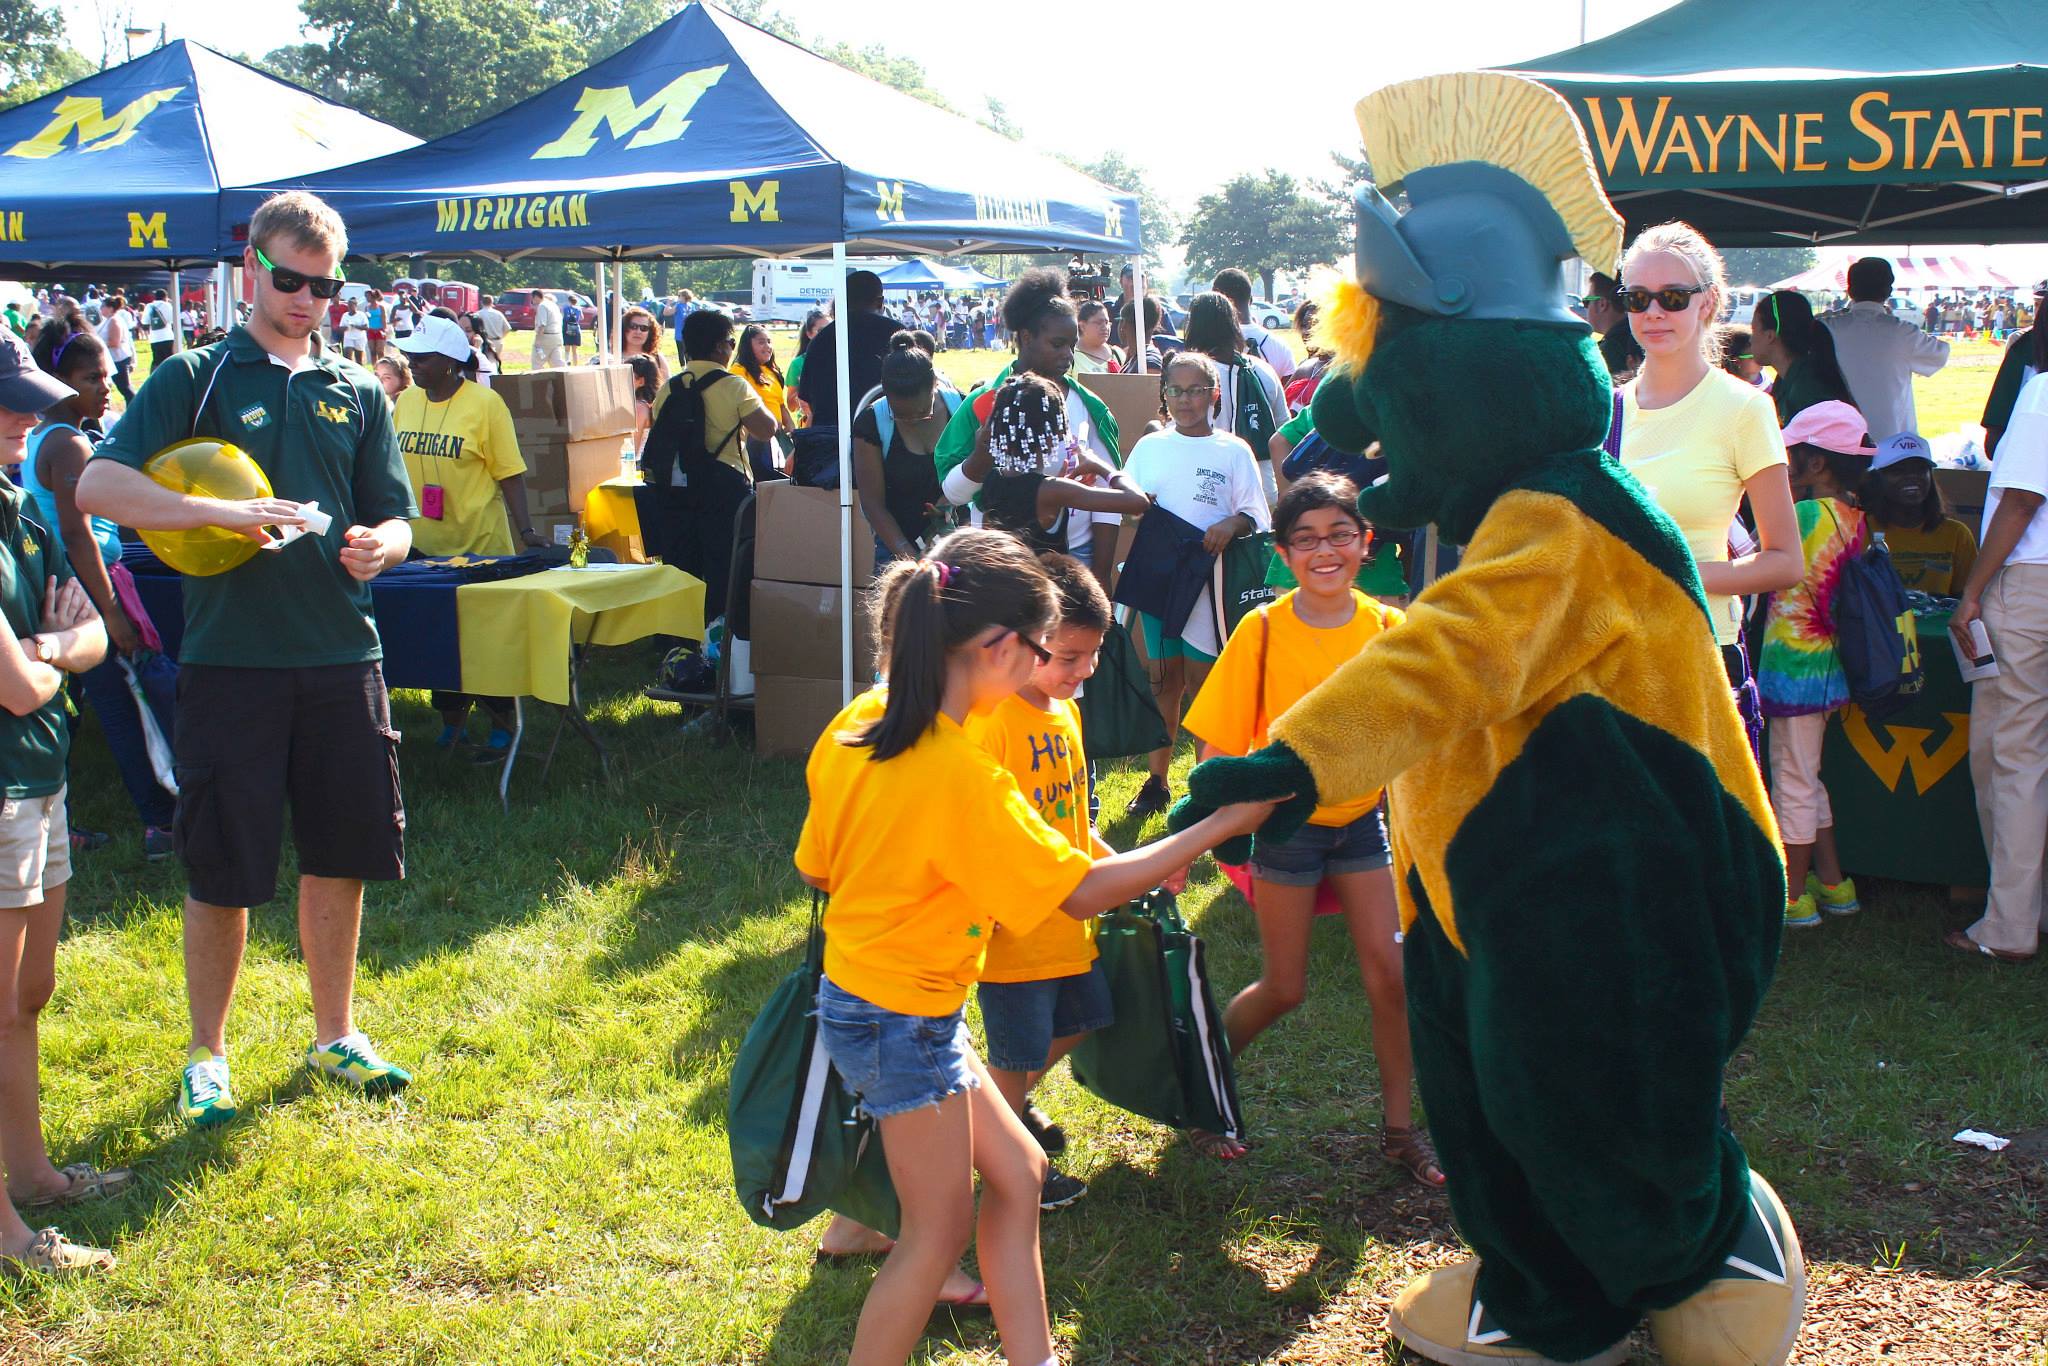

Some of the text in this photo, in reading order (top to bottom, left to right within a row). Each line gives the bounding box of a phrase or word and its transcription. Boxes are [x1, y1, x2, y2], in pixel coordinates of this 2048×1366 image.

[2, 86, 188, 160] M
[529, 63, 730, 160] M
[1583, 90, 2048, 177] WAYNE STATE
[435, 192, 590, 233] MICHIGAN
[729, 180, 782, 223] M
[876, 181, 906, 222] M
[127, 211, 169, 249] M
[799, 287, 834, 295] DETROIT
[1899, 442, 1917, 450] VIP
